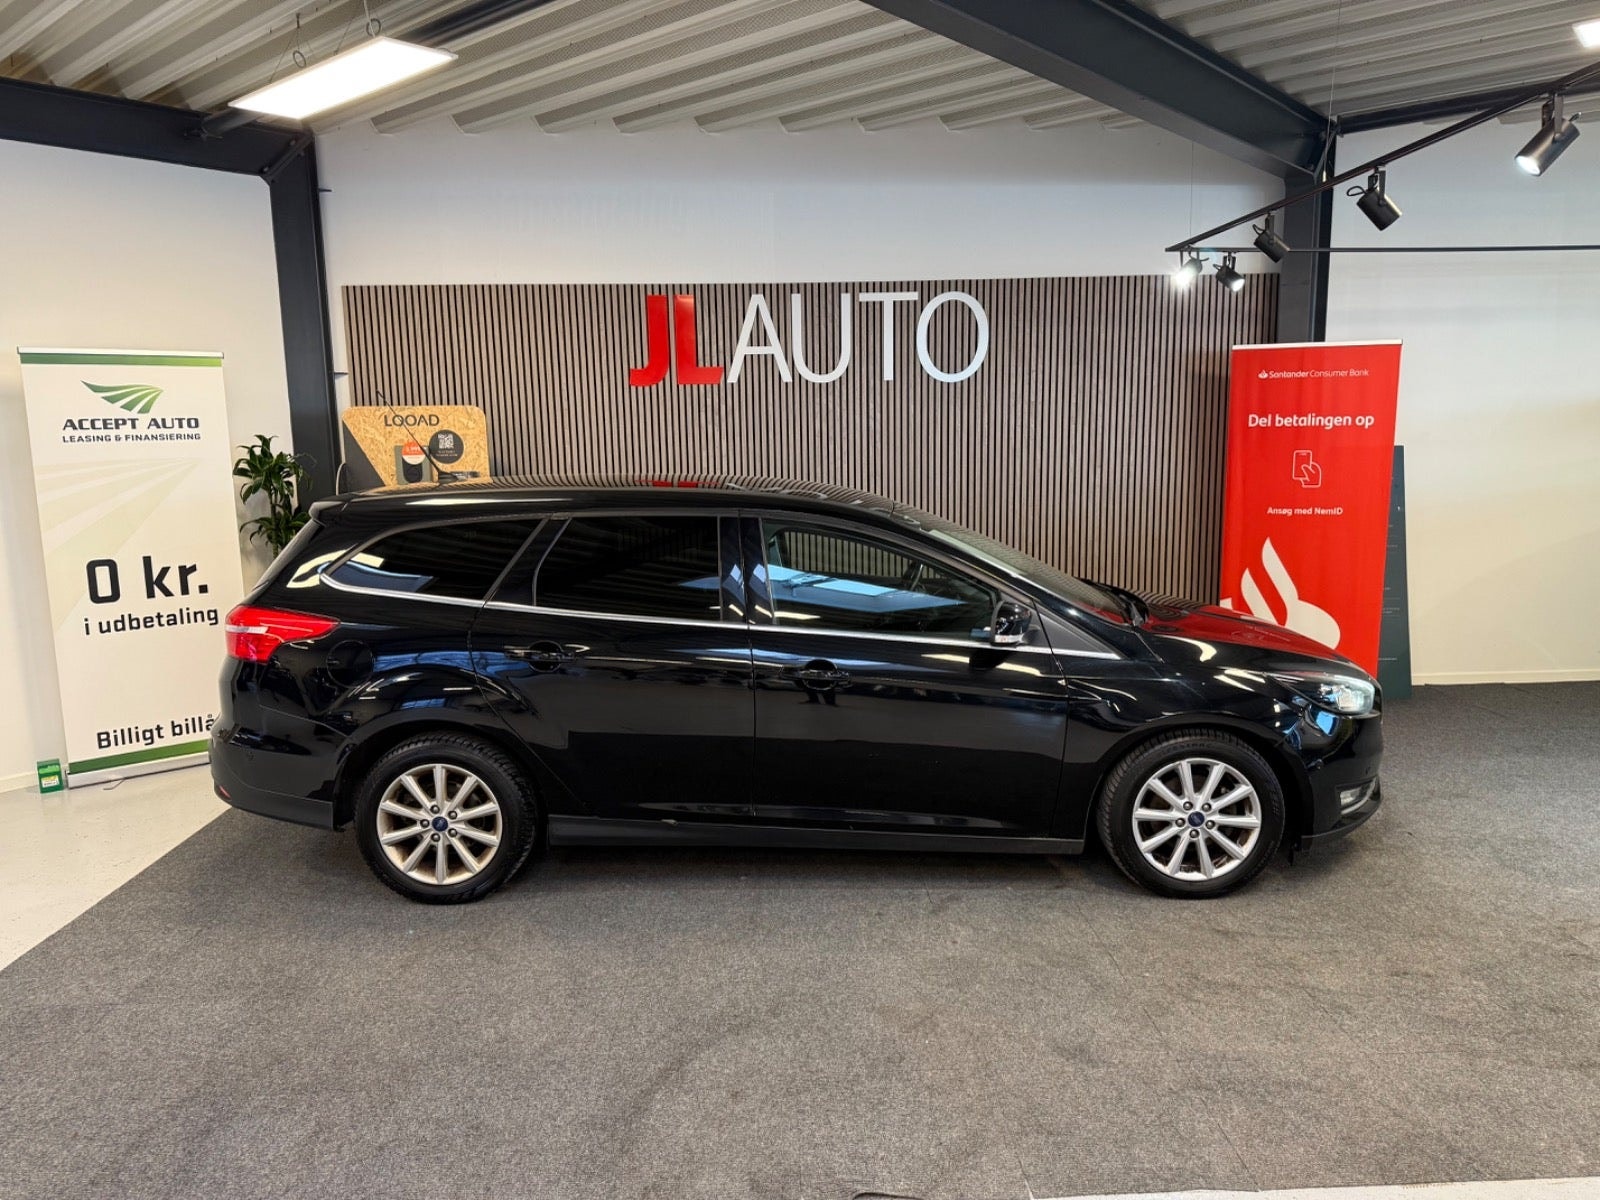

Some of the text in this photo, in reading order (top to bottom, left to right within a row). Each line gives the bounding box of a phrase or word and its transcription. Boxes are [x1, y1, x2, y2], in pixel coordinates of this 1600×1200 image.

[1269, 368, 1369, 379] Santander Consumer Bank
[62, 417, 200, 431] ACCEPT AUTO
[384, 414, 440, 427] LOOAD
[1248, 413, 1375, 430] Del betalingen op
[62, 433, 201, 443] LEASING & FINANSIERING
[1267, 506, 1344, 517] Ansøg med NemID
[86, 555, 209, 605] 0 kr.
[84, 607, 219, 635] i udbetaling
[97, 724, 164, 749] Billigt
